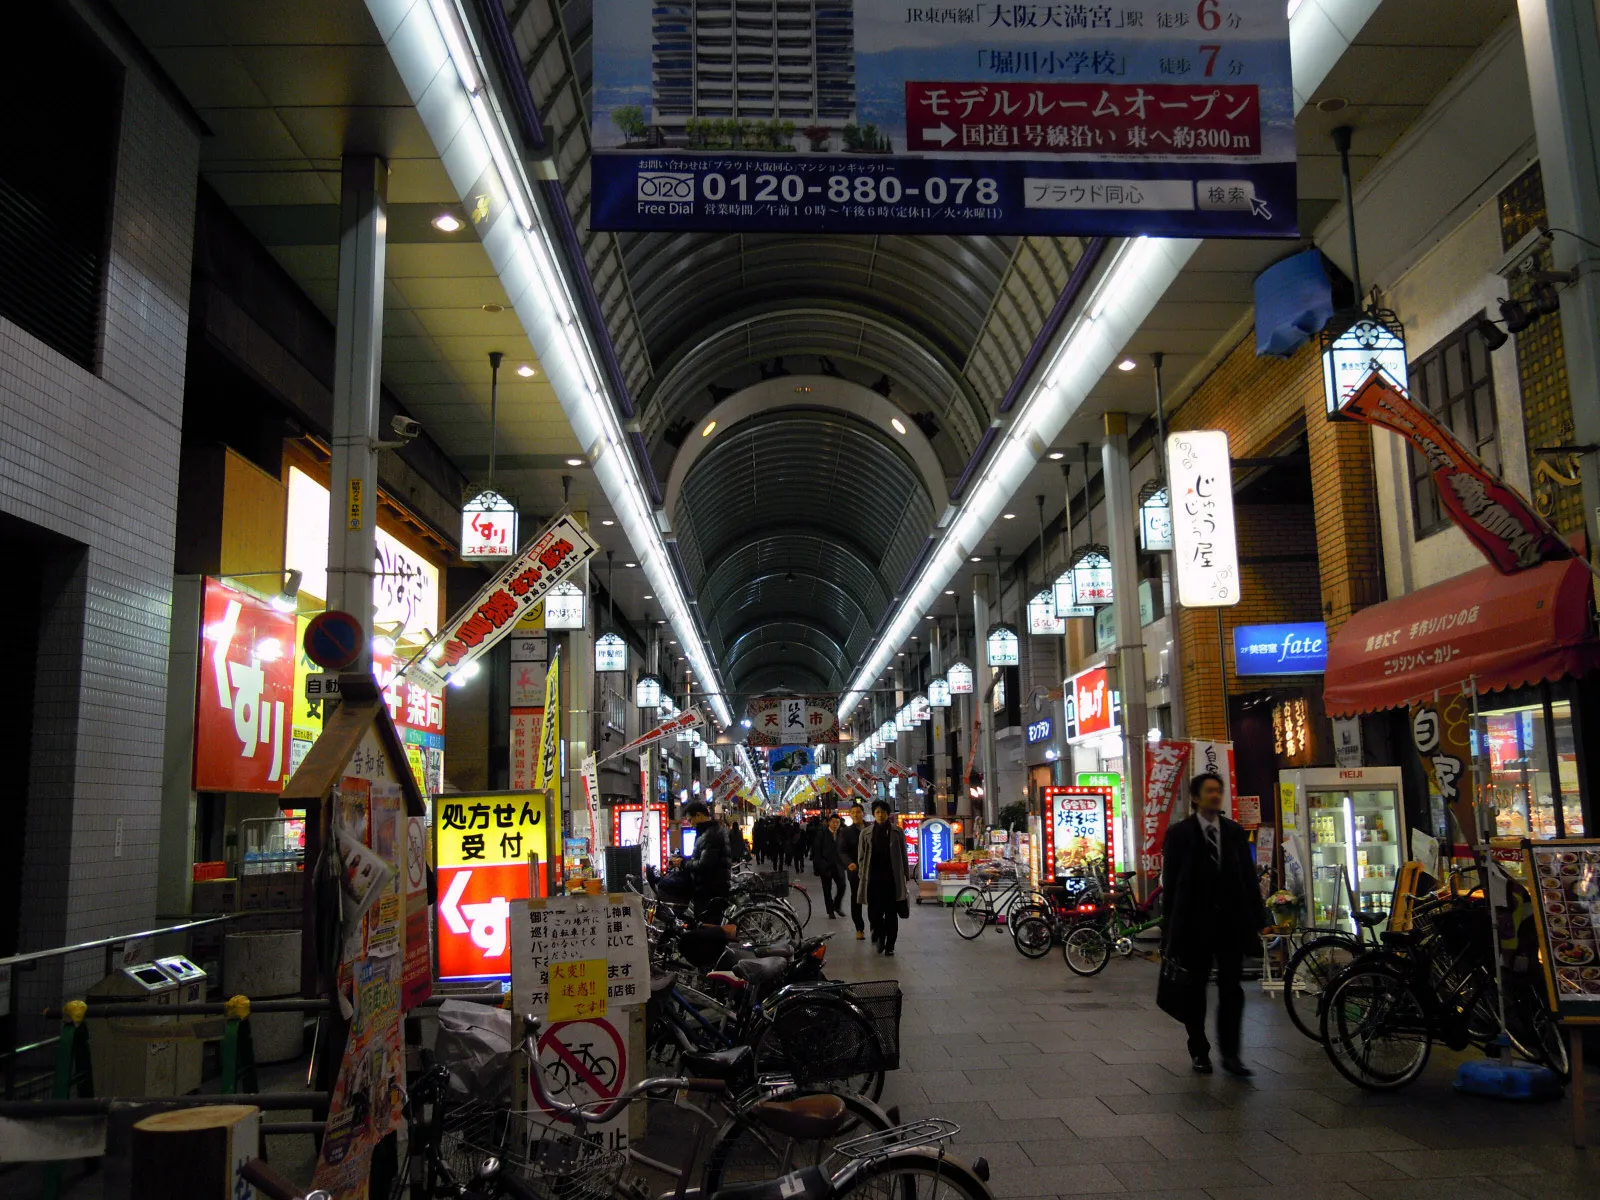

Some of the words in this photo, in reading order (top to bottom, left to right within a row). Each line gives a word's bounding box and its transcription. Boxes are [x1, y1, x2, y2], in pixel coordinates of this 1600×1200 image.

[977, 50, 1126, 77] 「堀川小学校」
[919, 88, 1252, 121] モデルルームオープン
[962, 123, 1118, 149] 国道1号線沿い
[1127, 126, 1251, 151] 東へ約300m
[702, 174, 1001, 205] 0120-880-078
[1034, 185, 1144, 205] プラウド同心
[1208, 186, 1246, 206] 検索
[637, 202, 668, 215] Free
[671, 202, 694, 215] Dial
[471, 513, 506, 545] くすり
[467, 547, 508, 557] スギ薬局
[1364, 632, 1402, 653] 焼きたて
[1409, 605, 1480, 644] 手作りパンの店
[1249, 646, 1278, 659] 美容室
[1276, 634, 1323, 664] fate
[212, 598, 286, 783] くすり
[765, 713, 779, 727] 天
[810, 712, 824, 726] 市
[442, 801, 541, 831] 処方せん
[461, 831, 524, 860] 受付
[1073, 825, 1095, 839] 390
